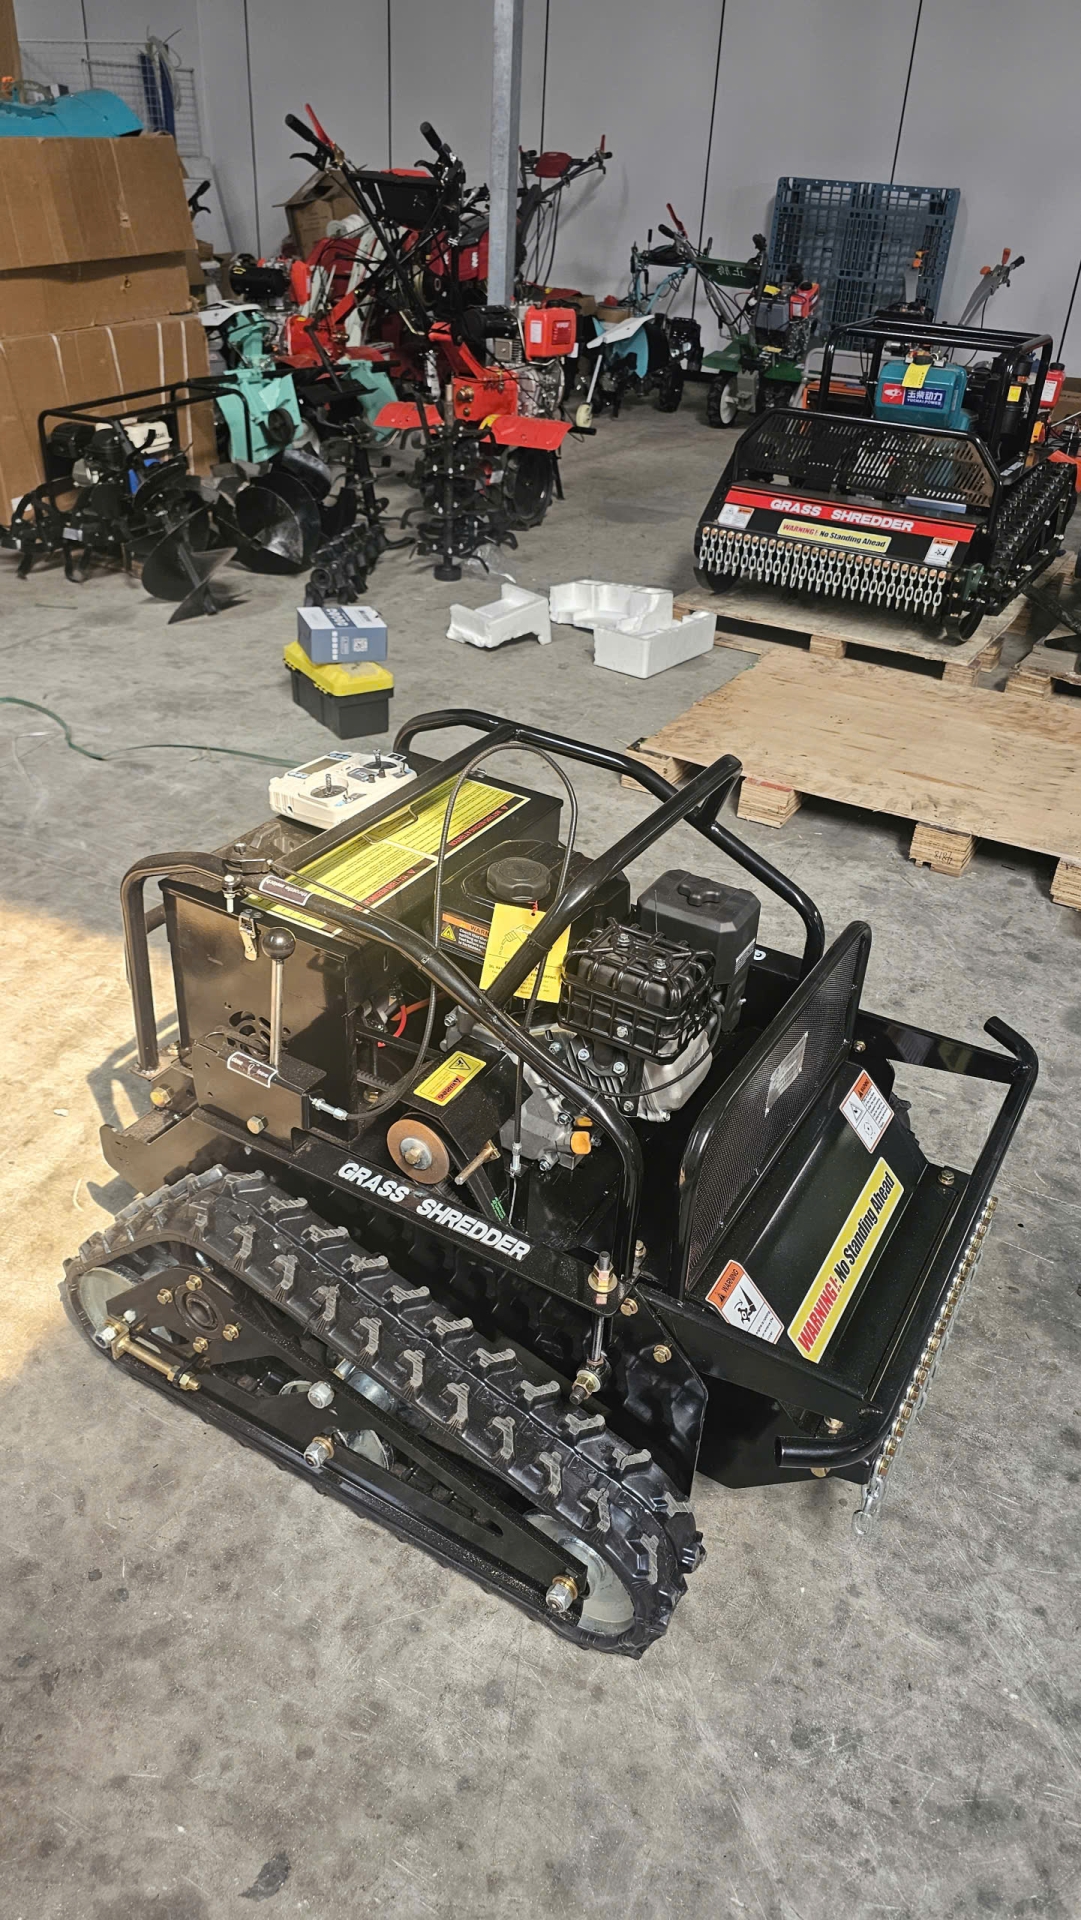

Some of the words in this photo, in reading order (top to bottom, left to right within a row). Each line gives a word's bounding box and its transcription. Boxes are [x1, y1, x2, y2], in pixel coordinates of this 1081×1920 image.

[770, 499, 822, 516] GRASS
[831, 509, 914, 531] SHREDDER
[819, 530, 829, 538] No
[830, 532, 861, 544] Standing
[862, 538, 886, 548] Ahead
[337, 1162, 410, 1203] GRASS
[416, 1198, 532, 1261] SHREDDER
[833, 1258, 851, 1284] No
[843, 1208, 878, 1265] Standing
[870, 1171, 895, 1215] Ahead
[722, 1268, 739, 1292] WARNING
